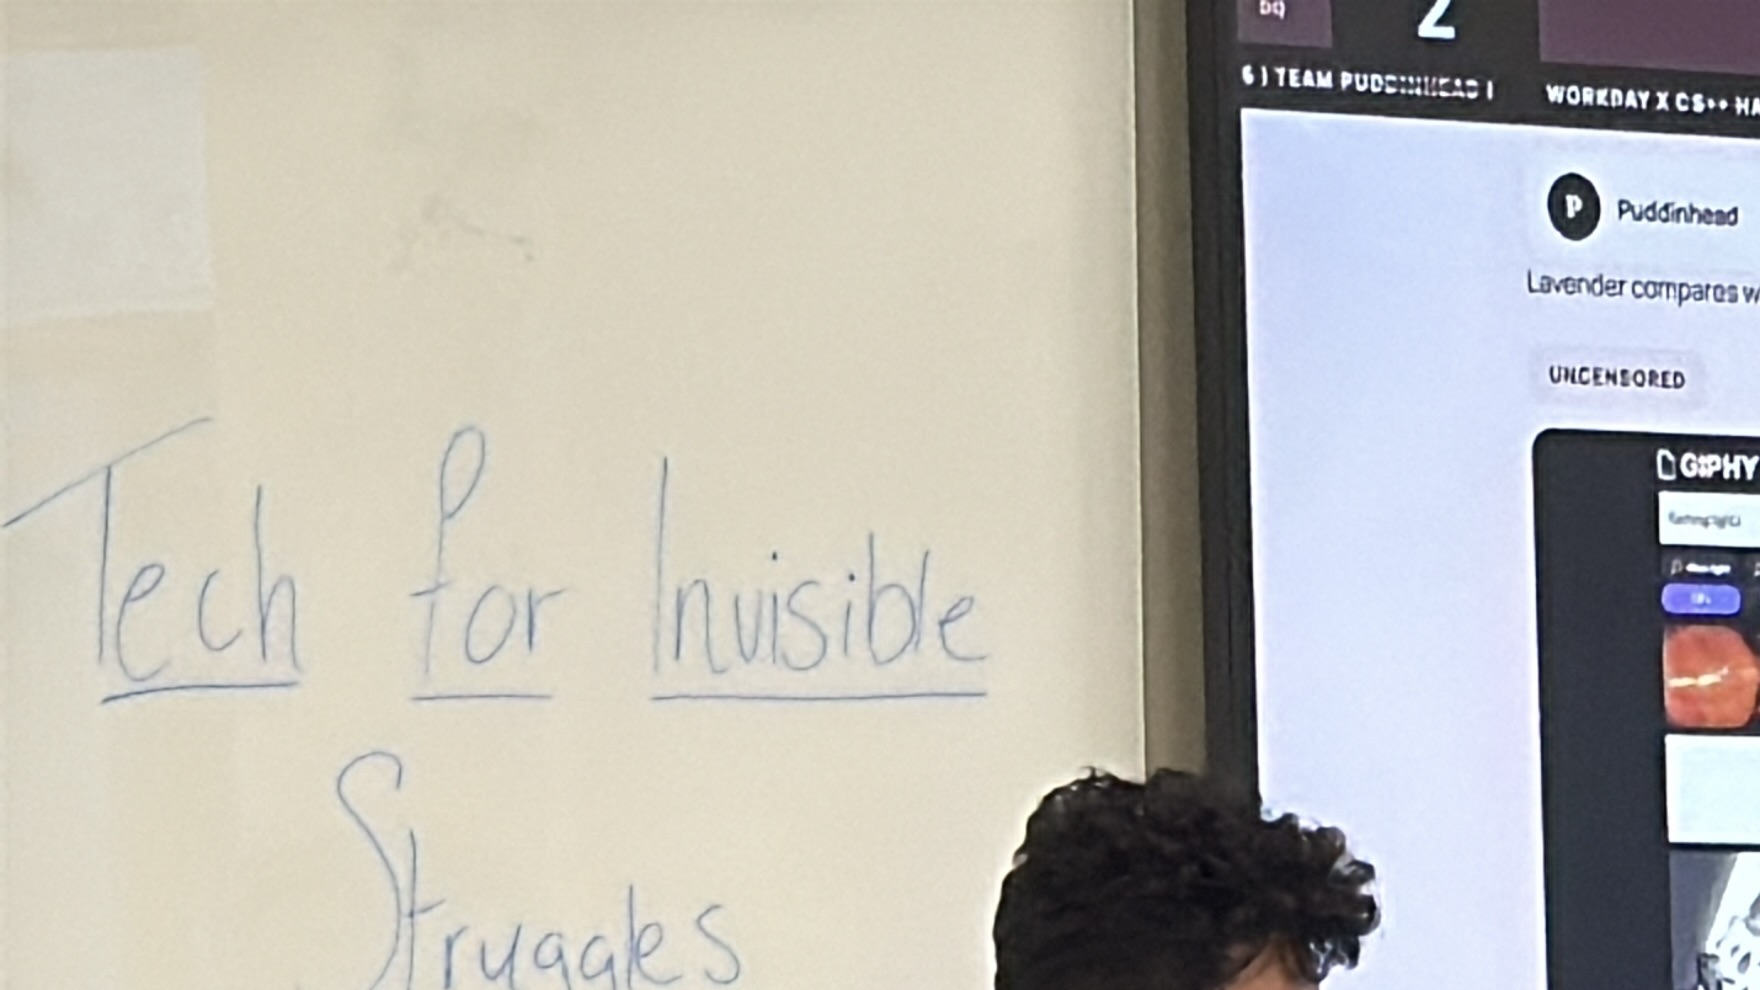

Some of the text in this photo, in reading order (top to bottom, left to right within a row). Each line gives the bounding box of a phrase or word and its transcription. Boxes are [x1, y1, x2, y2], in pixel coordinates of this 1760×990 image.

[1274, 66, 1333, 89] TEAM
[1545, 84, 1650, 111] WORKDAY
[1655, 91, 1670, 112] X
[1564, 194, 1583, 219] P
[1617, 198, 1739, 227] Puddinhead
[1526, 269, 1627, 298] Lavender
[1631, 279, 1739, 308] compares
[1549, 365, 1686, 389] UNCENSORED
[1679, 452, 1760, 481] GIPHY
[2, 416, 988, 684] Tech for Invisible
